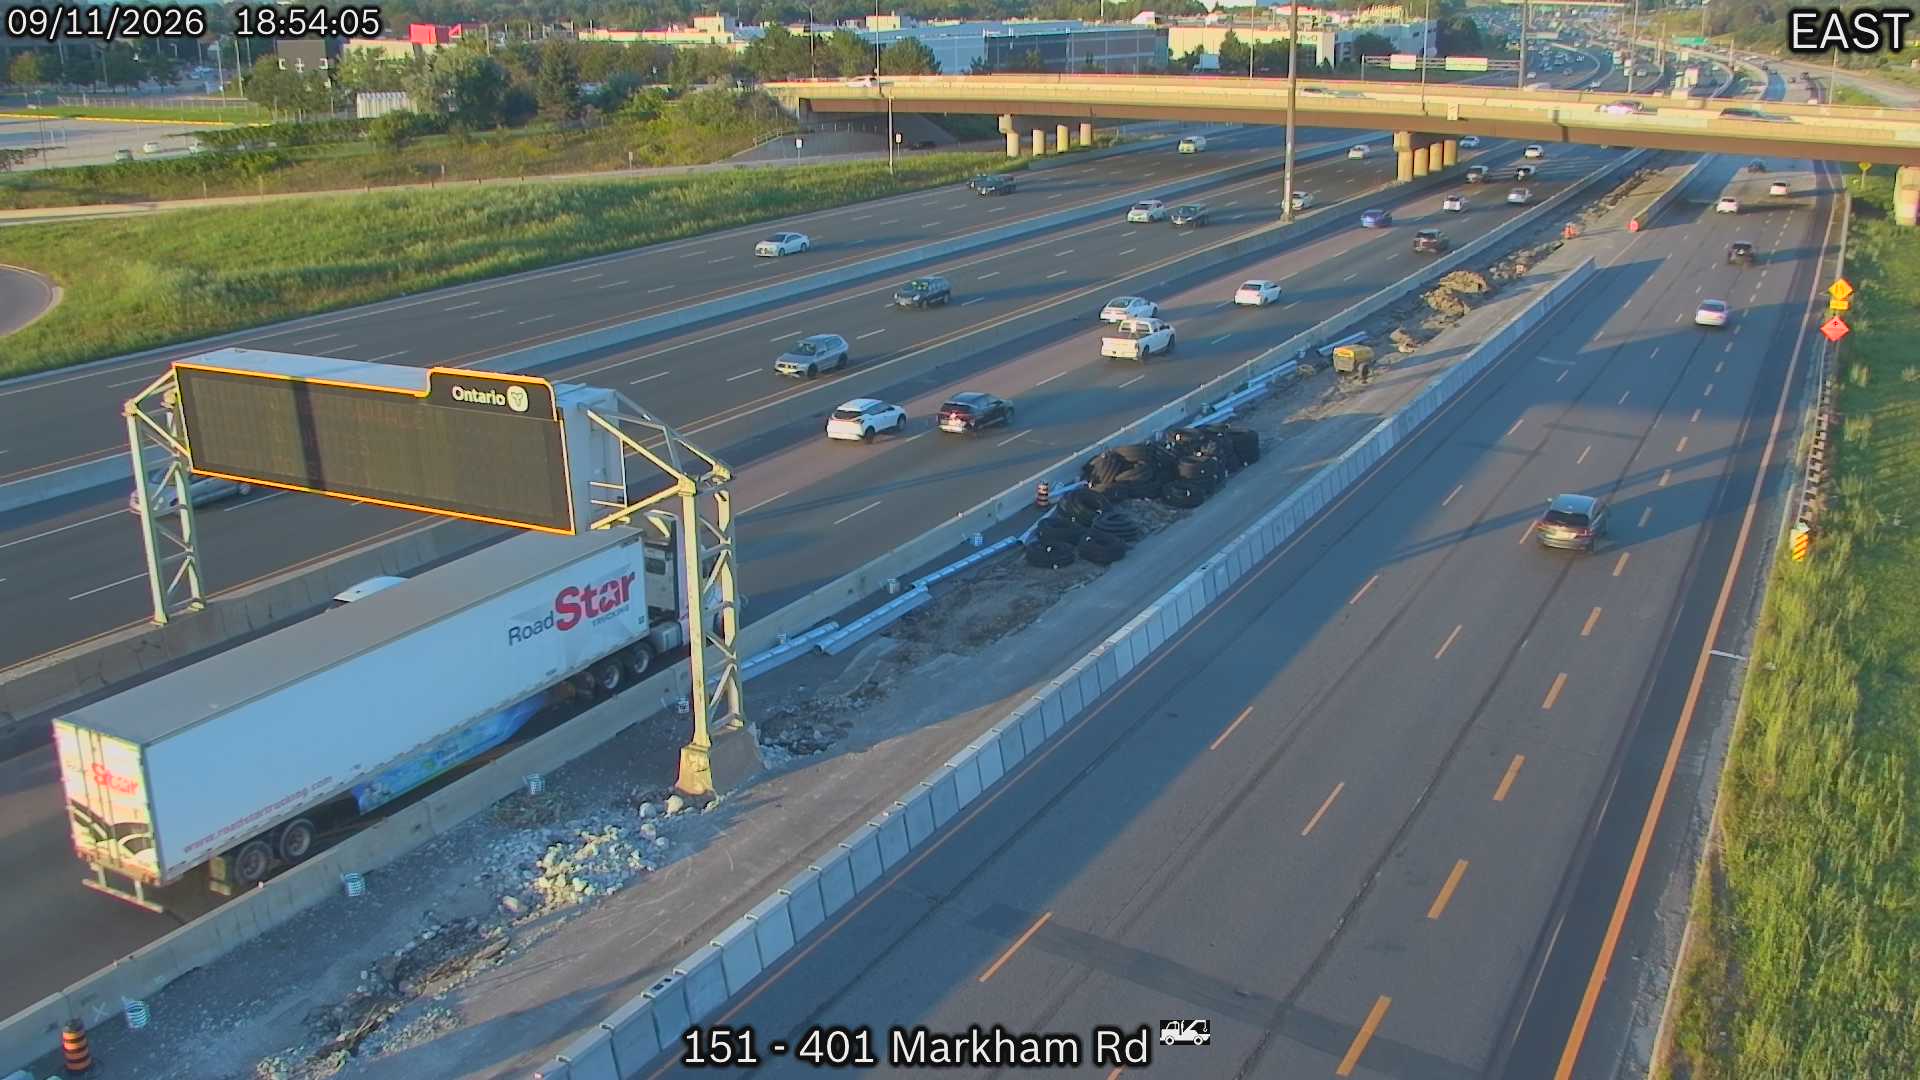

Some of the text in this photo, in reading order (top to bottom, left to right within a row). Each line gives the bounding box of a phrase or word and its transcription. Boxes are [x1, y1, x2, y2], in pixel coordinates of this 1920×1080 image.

[452, 385, 506, 406] Ontario
[508, 571, 635, 646] Road Star
[91, 762, 139, 796] Star
